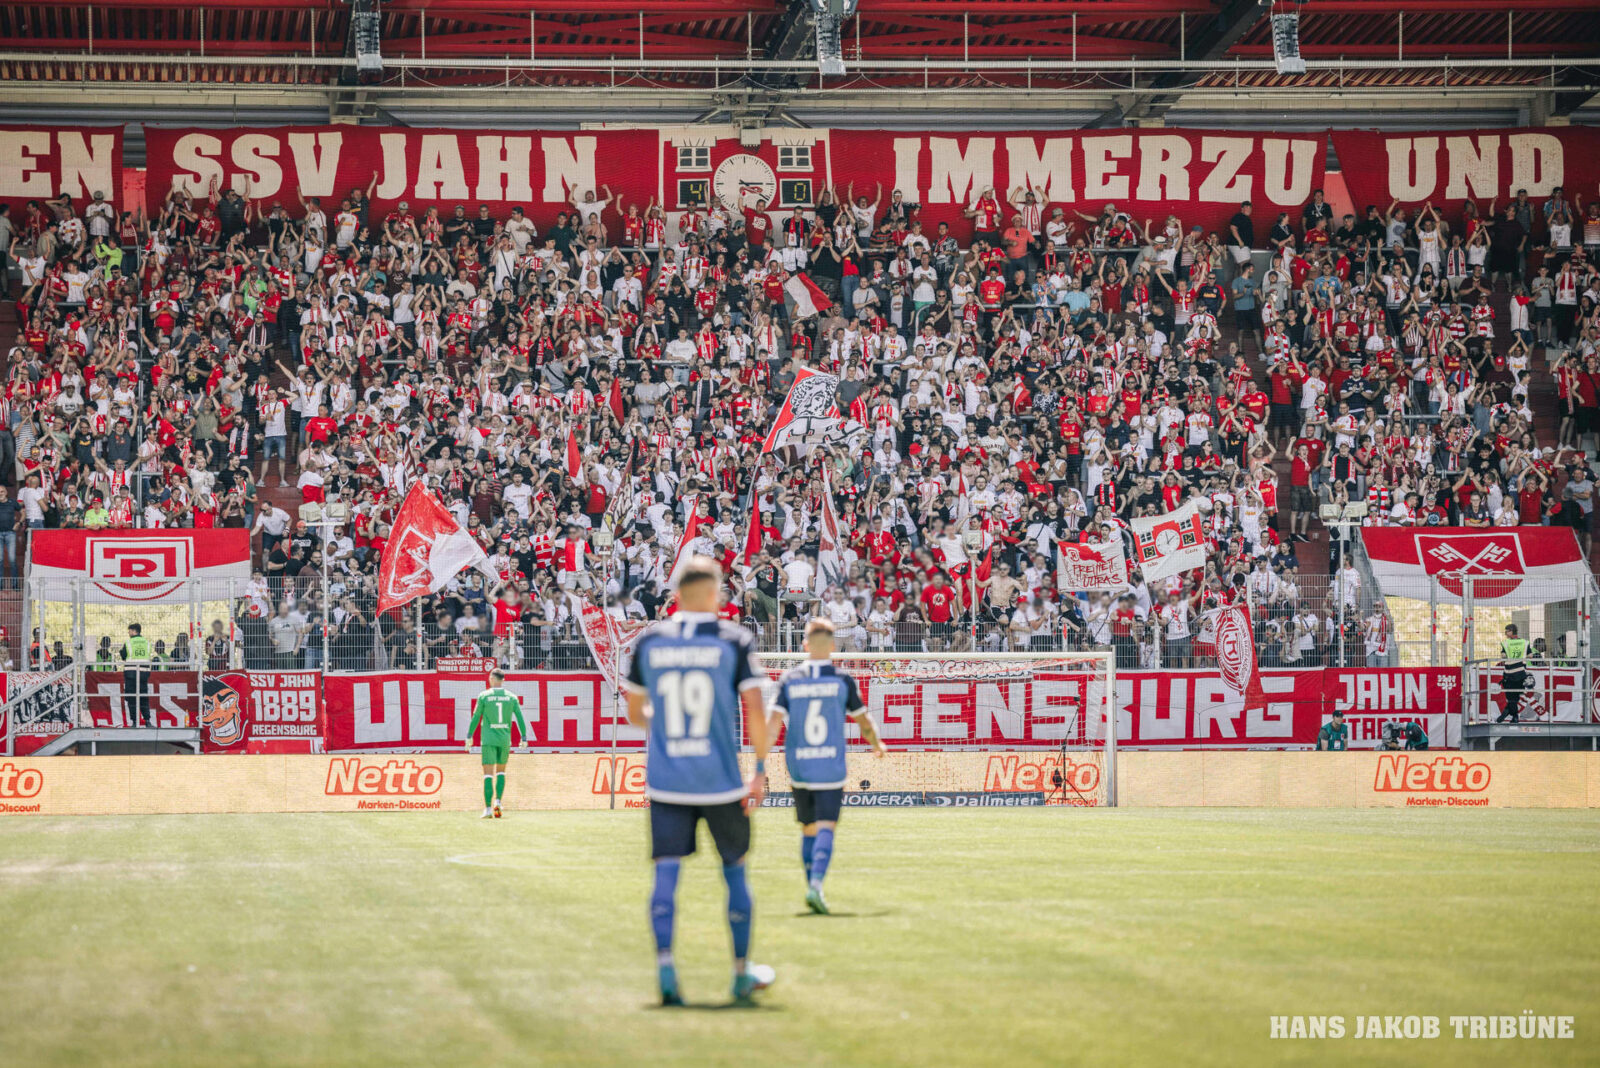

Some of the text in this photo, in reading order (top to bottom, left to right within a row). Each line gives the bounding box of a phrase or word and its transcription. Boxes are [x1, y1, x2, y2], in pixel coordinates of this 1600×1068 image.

[172, 132, 342, 199] SSV
[377, 133, 597, 202] JAHN
[892, 135, 1317, 206] IMMERZU
[1385, 133, 1564, 202] UND
[134, 649, 146, 657] 643
[249, 674, 315, 688] SSV JAHN
[1335, 673, 1427, 711] JAHN
[251, 690, 316, 722] 1889
[495, 702, 503, 723] 1
[657, 670, 714, 738] 19
[252, 724, 317, 736] REGENSBURG
[804, 700, 828, 746] 6
[324, 758, 444, 796] Netto
[984, 756, 1100, 793] Netto
[1374, 754, 1492, 792] Netto
[357, 800, 442, 809] Marken-Discount
[956, 795, 1038, 807] Dallmeier
[1406, 797, 1489, 806] Marken-Discount
